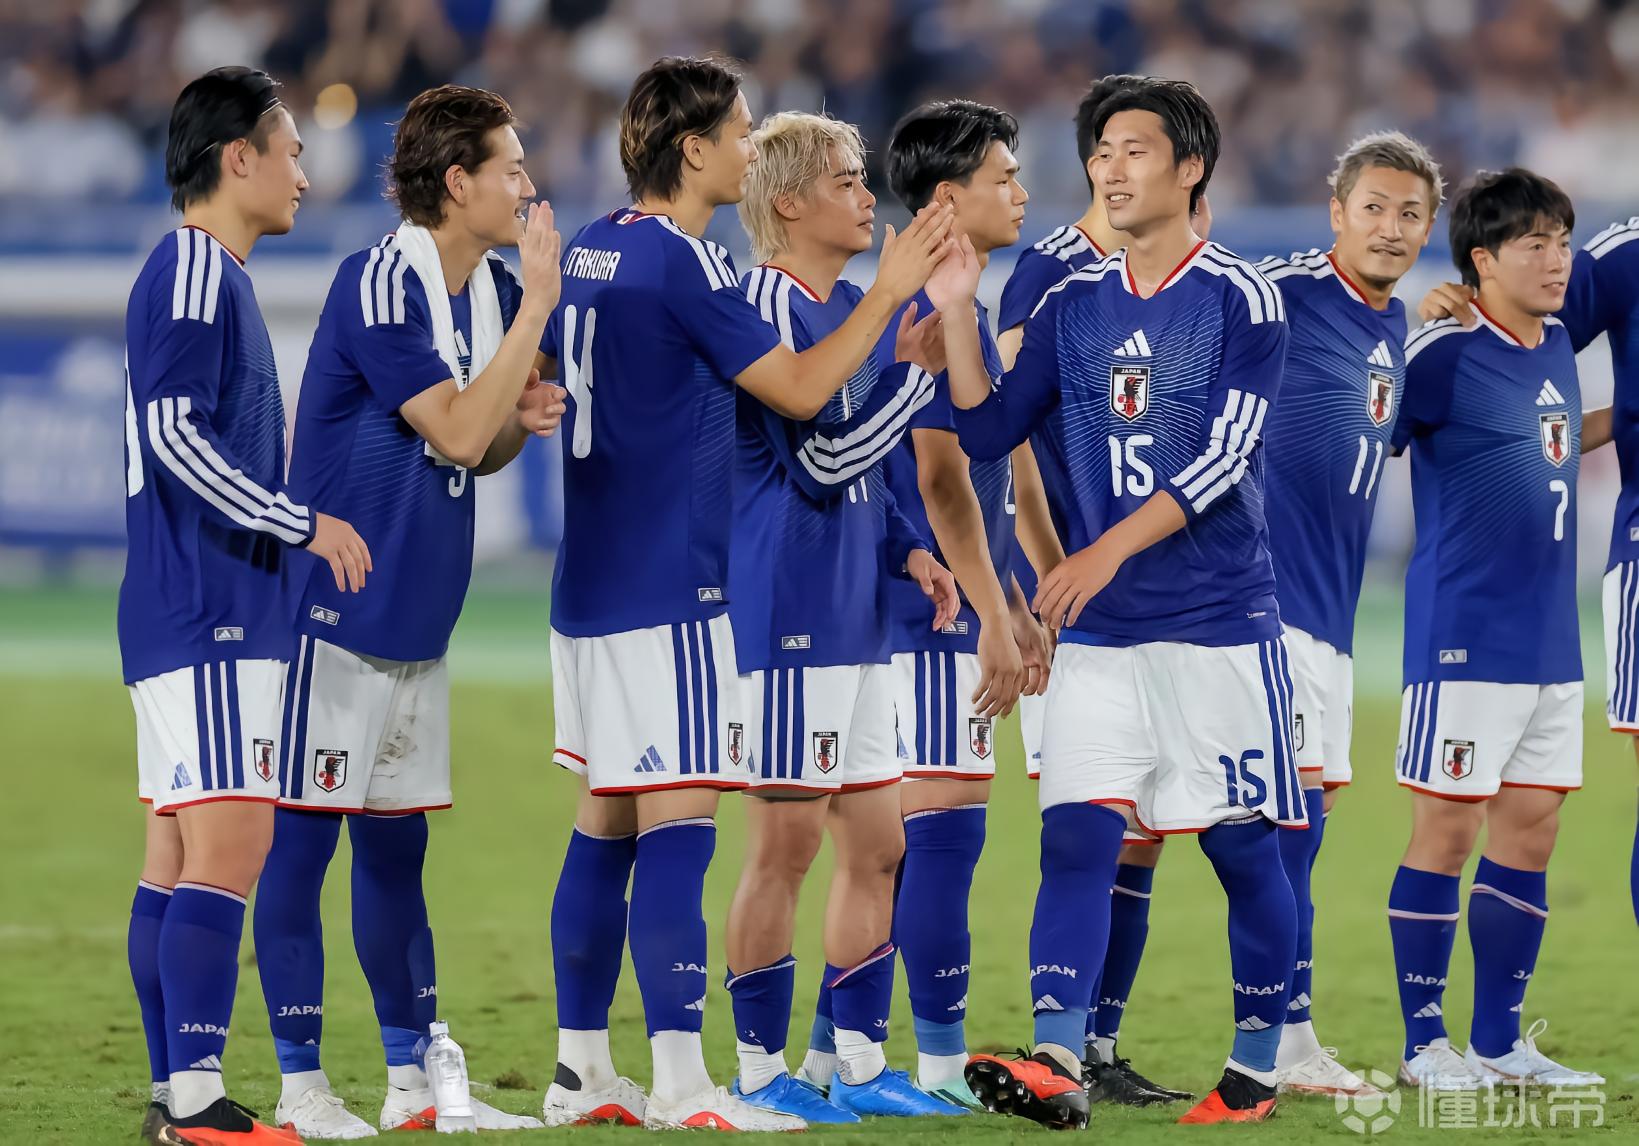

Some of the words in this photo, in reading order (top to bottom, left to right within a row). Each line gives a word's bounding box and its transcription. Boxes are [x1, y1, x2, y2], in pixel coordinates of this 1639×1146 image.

[562, 246, 622, 281] ITAKURA
[563, 304, 597, 459] 4
[1121, 403, 1139, 412] JFA
[1108, 434, 1154, 498] 15
[1349, 435, 1383, 500] 11
[1549, 480, 1569, 541] 7
[1218, 749, 1267, 808] 15
[934, 964, 970, 978] JAP
[1030, 964, 1078, 980] APAN
[1232, 980, 1285, 995] APAN
[1404, 973, 1447, 986] JAPA
[277, 1005, 323, 1017] JAPA
[179, 1023, 229, 1037] JAPA
